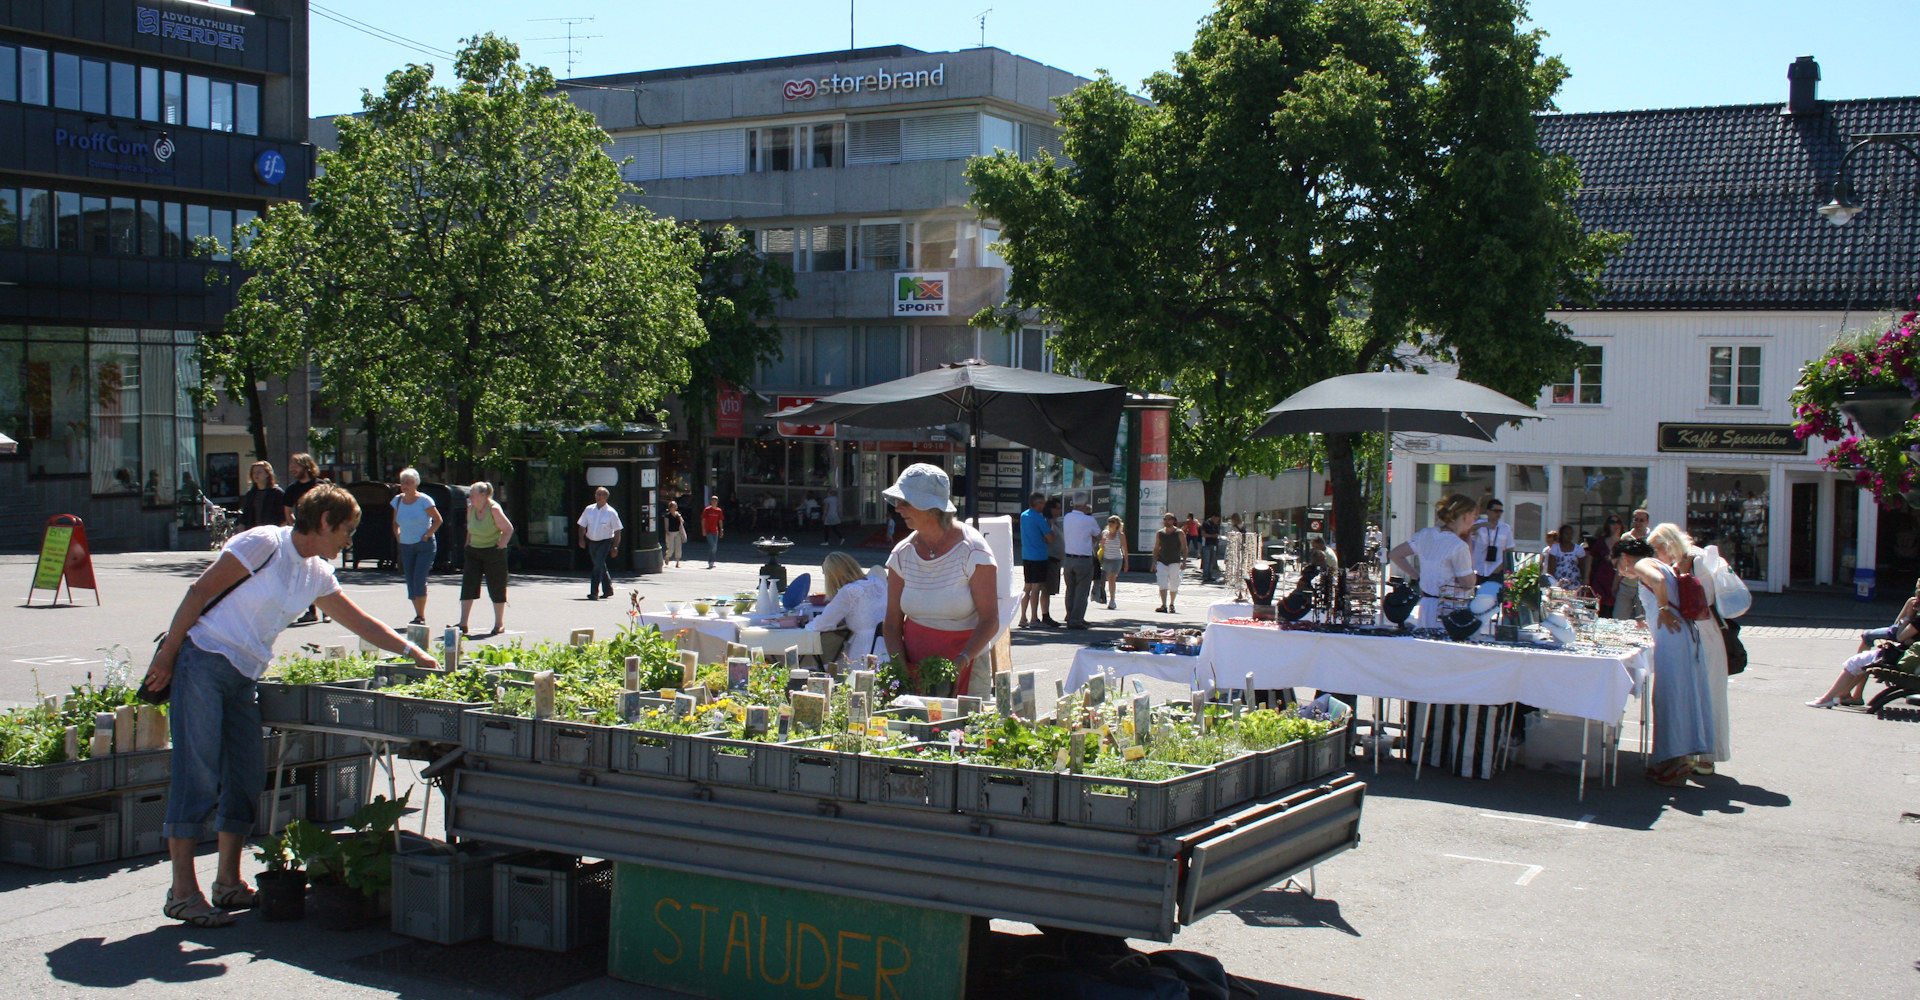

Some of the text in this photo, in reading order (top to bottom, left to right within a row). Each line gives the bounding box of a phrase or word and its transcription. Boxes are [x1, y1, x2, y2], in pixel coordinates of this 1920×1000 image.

[161, 20, 244, 51] FÆRDER
[162, 11, 246, 34] ADVOKATHUSET
[820, 63, 944, 96] storebrand
[898, 303, 945, 312] SPORT
[1677, 429, 1789, 448] Kaffe Spesialen
[653, 898, 911, 1000] STAUDER
